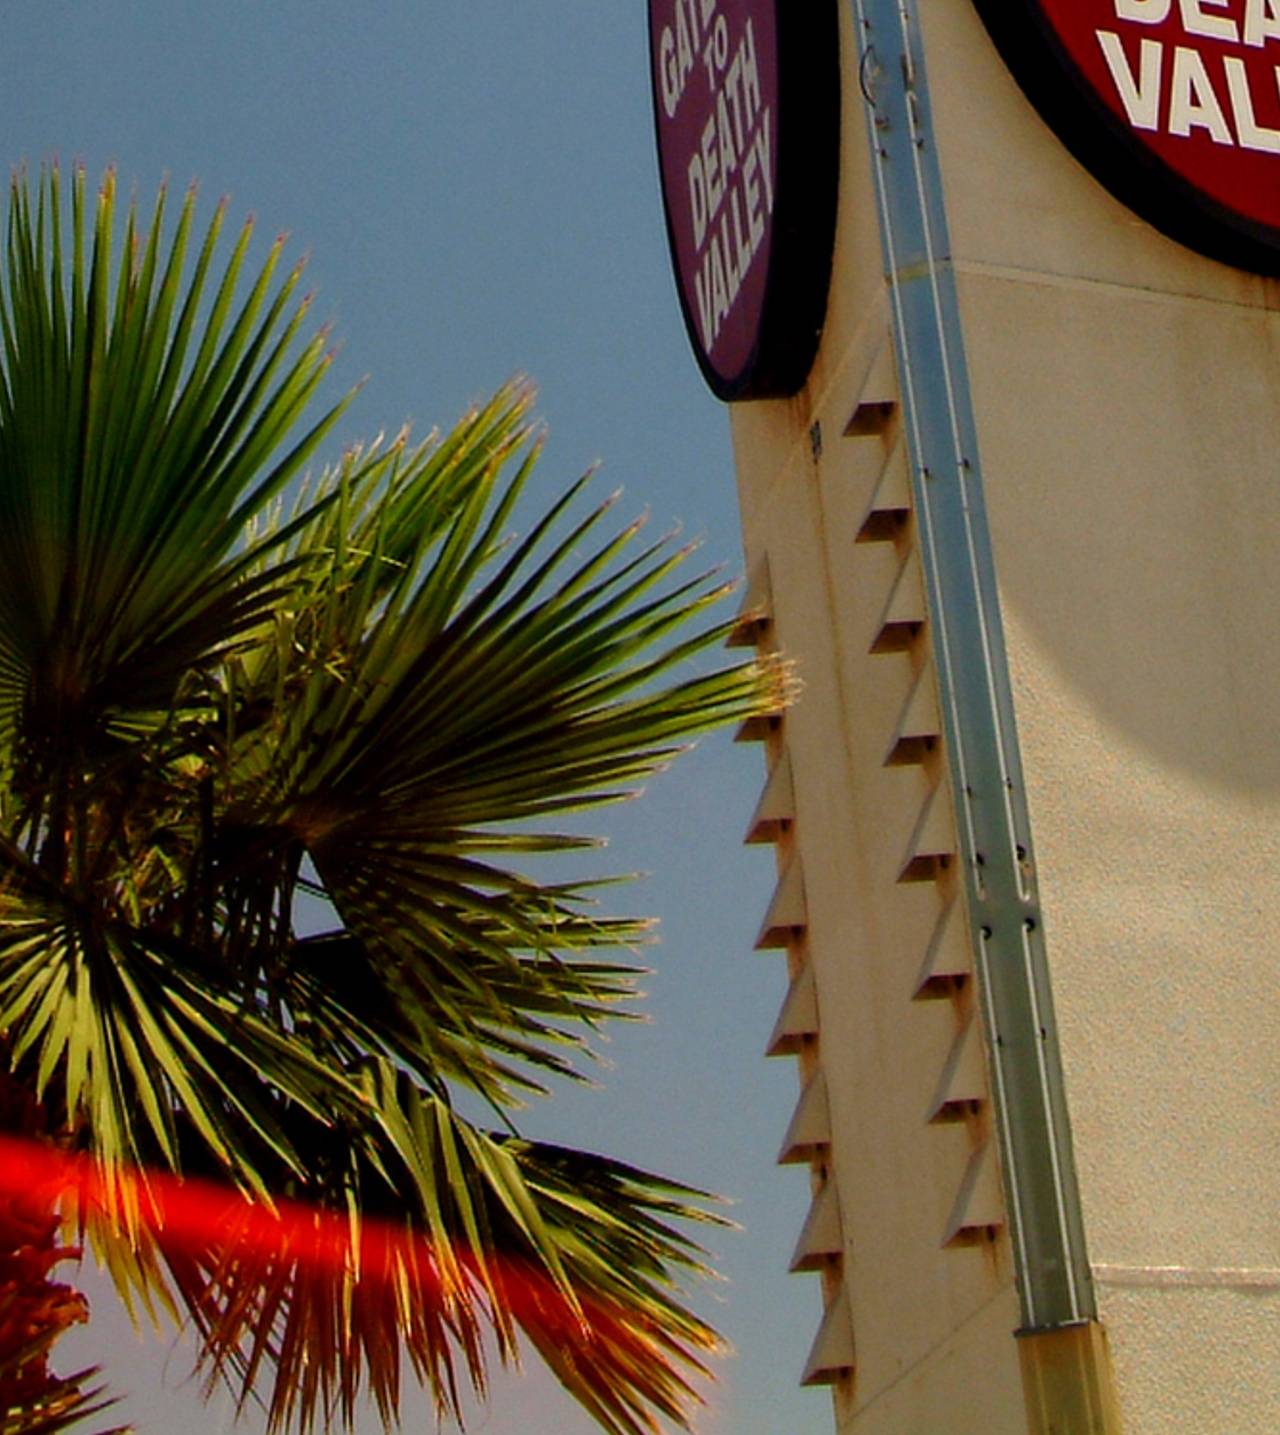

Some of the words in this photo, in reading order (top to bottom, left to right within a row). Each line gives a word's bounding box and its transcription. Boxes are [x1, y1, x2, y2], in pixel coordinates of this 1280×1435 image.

[687, 18, 762, 251] DEATH
[703, 14, 728, 92] TO
[694, 127, 773, 354] VALLEY
